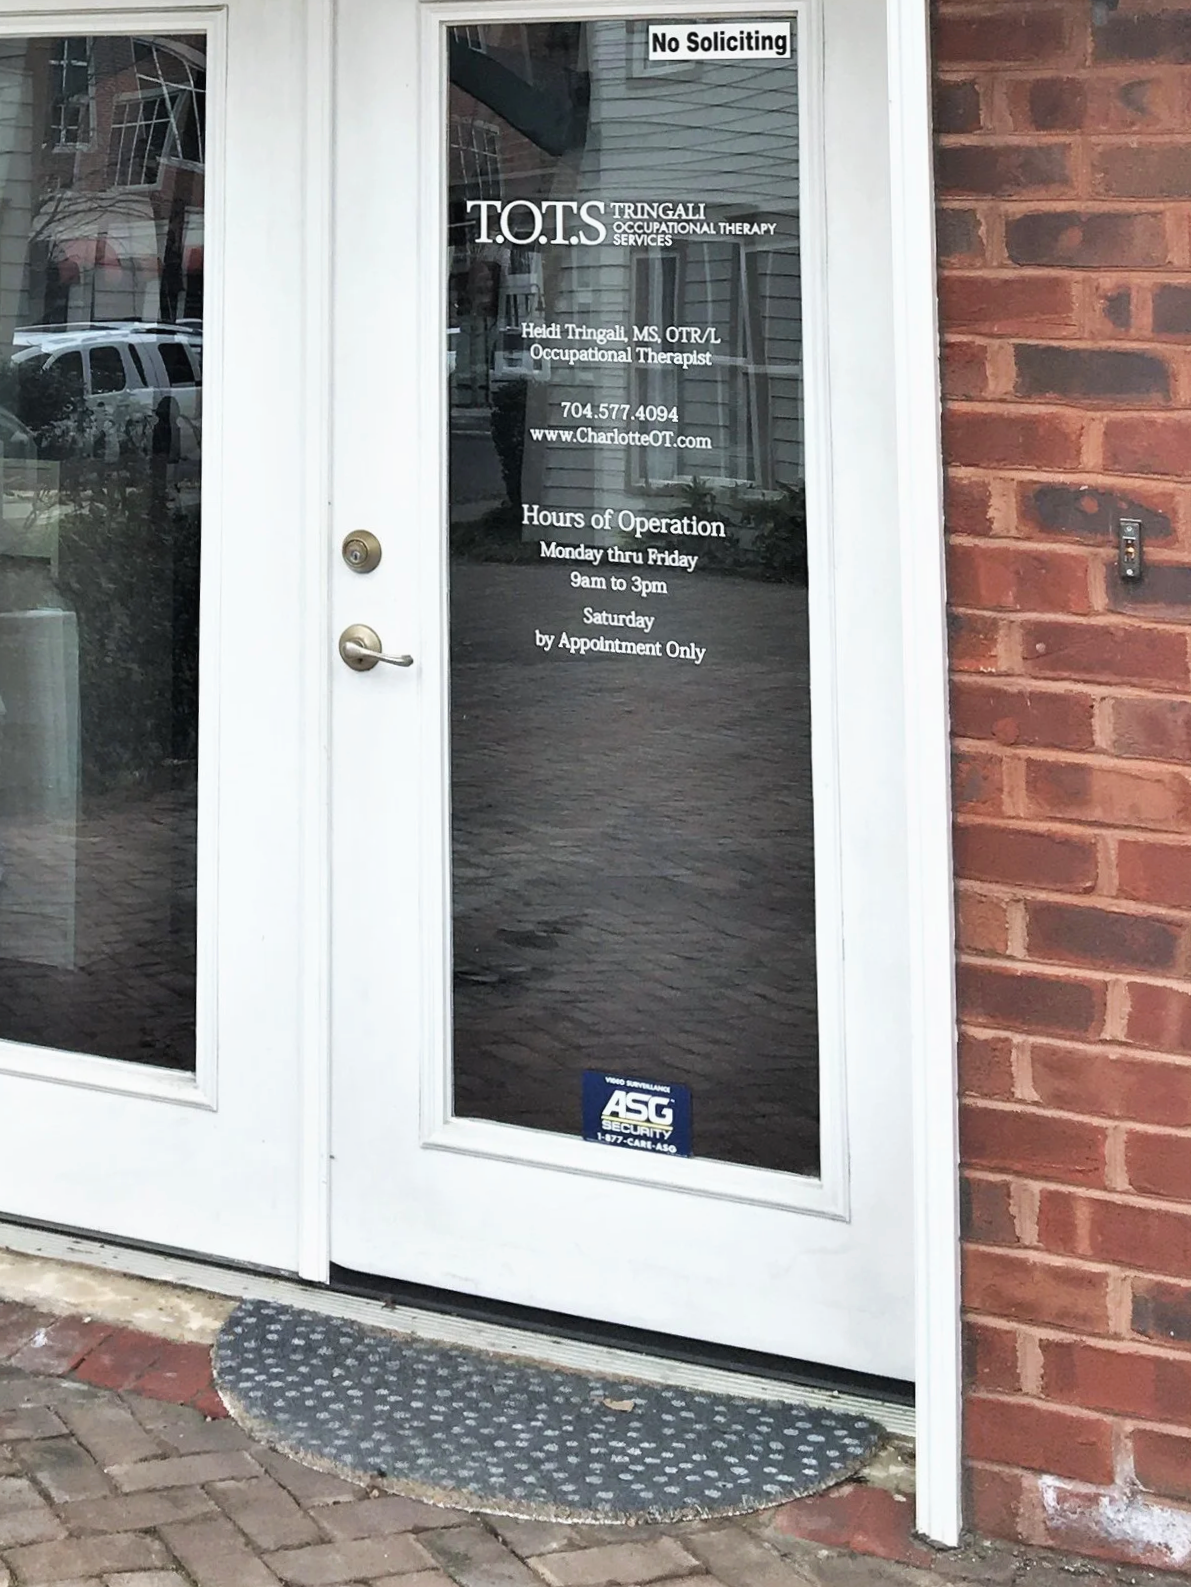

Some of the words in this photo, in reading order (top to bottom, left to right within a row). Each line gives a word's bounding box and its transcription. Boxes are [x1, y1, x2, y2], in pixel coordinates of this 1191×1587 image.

[652, 32, 680, 53] No
[686, 30, 788, 55] Soliciting
[610, 202, 706, 220] TRINGALI
[612, 221, 716, 236] OCCUPATIONAL
[718, 222, 777, 236] THERAPY
[612, 234, 673, 247] SERVICES
[521, 323, 561, 340] Heidi
[564, 323, 629, 345] Tringali,
[633, 325, 661, 344] MS,
[666, 326, 722, 345] OTR/L
[530, 344, 632, 365] Occupational
[636, 347, 713, 369] Therapist
[561, 402, 679, 423] 704.577.4094
[530, 427, 713, 450] www.CharlotteOT.com
[521, 503, 585, 529] Hours
[591, 509, 614, 530] of
[618, 510, 726, 538] Operation
[540, 541, 604, 566] Monday
[607, 547, 644, 565] thru
[647, 548, 698, 573] Friday
[570, 571, 607, 590] 9am
[610, 574, 627, 591] to
[631, 575, 668, 597] 3pm
[583, 607, 655, 633] Saturday
[535, 629, 555, 651] by
[558, 631, 662, 657] Appointment
[666, 641, 706, 665] Only
[605, 1076, 625, 1085] VIDEO
[626, 1079, 671, 1093] SURVEILLANCE
[601, 1090, 673, 1125] ASG
[601, 1120, 672, 1140] SECURITY
[596, 1132, 677, 1153] 1-877-CARE-ASG
